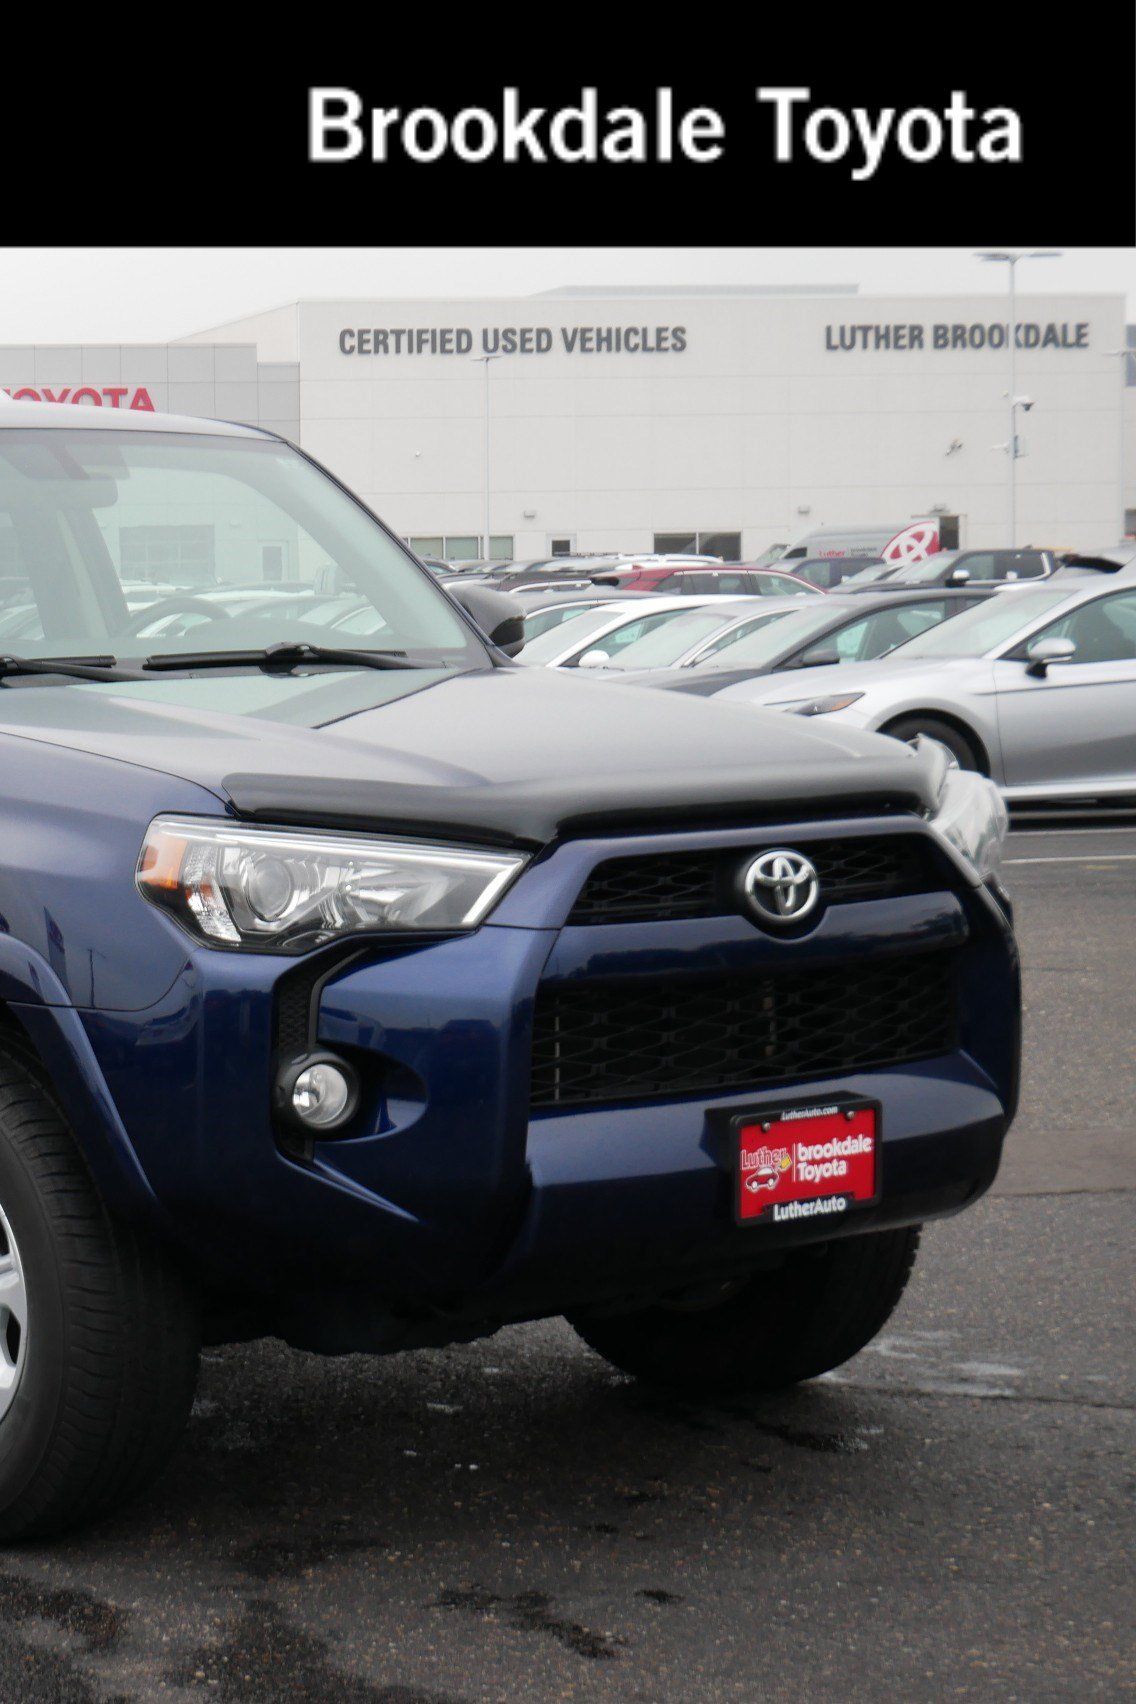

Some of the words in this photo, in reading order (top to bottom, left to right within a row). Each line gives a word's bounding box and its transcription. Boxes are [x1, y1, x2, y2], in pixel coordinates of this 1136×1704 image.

[338, 327, 473, 356] CERTIFIED
[481, 326, 554, 354] USED
[561, 325, 688, 354] VEHICLES
[824, 323, 925, 351] LUTHER
[932, 322, 1090, 350] BROOKDALE
[3, 387, 156, 412] OYOTA
[797, 1133, 873, 1162] brookdale
[797, 1158, 848, 1184] Toyota
[772, 1195, 847, 1222] LutherAuto
